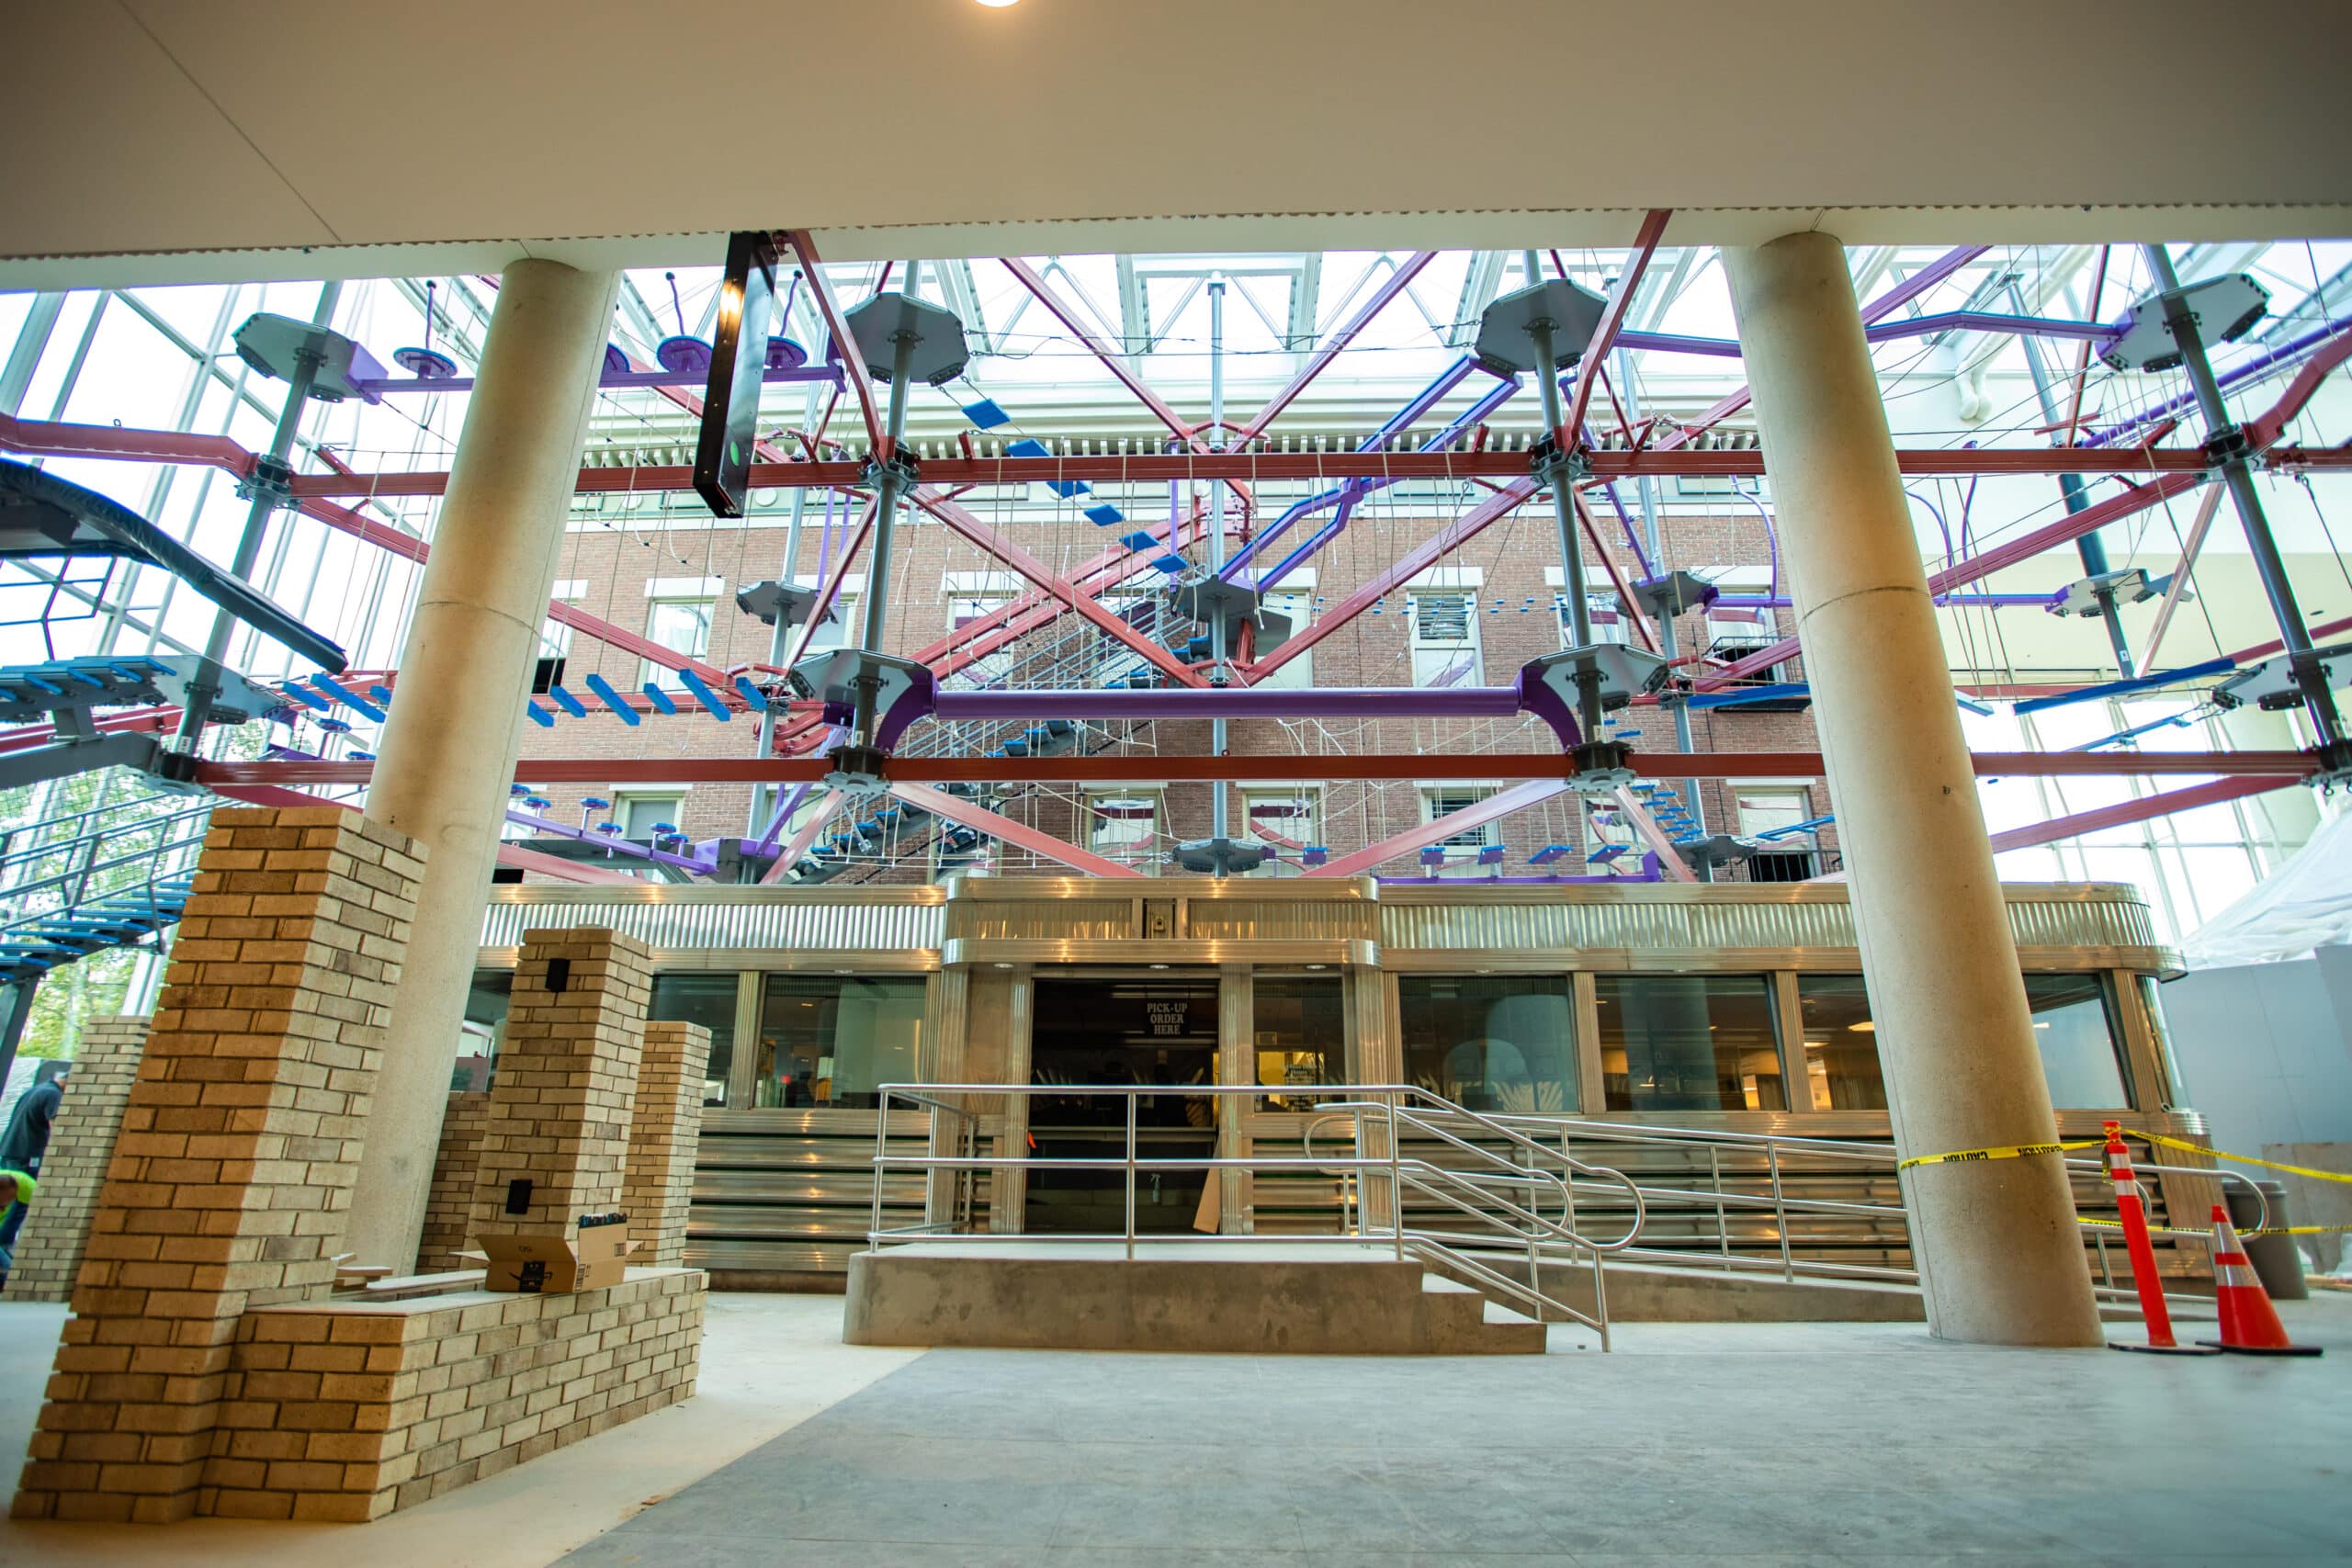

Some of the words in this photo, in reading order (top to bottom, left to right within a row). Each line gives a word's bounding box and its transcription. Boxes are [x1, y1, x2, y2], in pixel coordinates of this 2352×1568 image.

[1147, 1002, 1188, 1013] PICK-UP
[1149, 1013, 1184, 1024] ORDER
[1154, 1024, 1182, 1035] HERE
[1942, 1151, 1988, 1162] CAUTION
